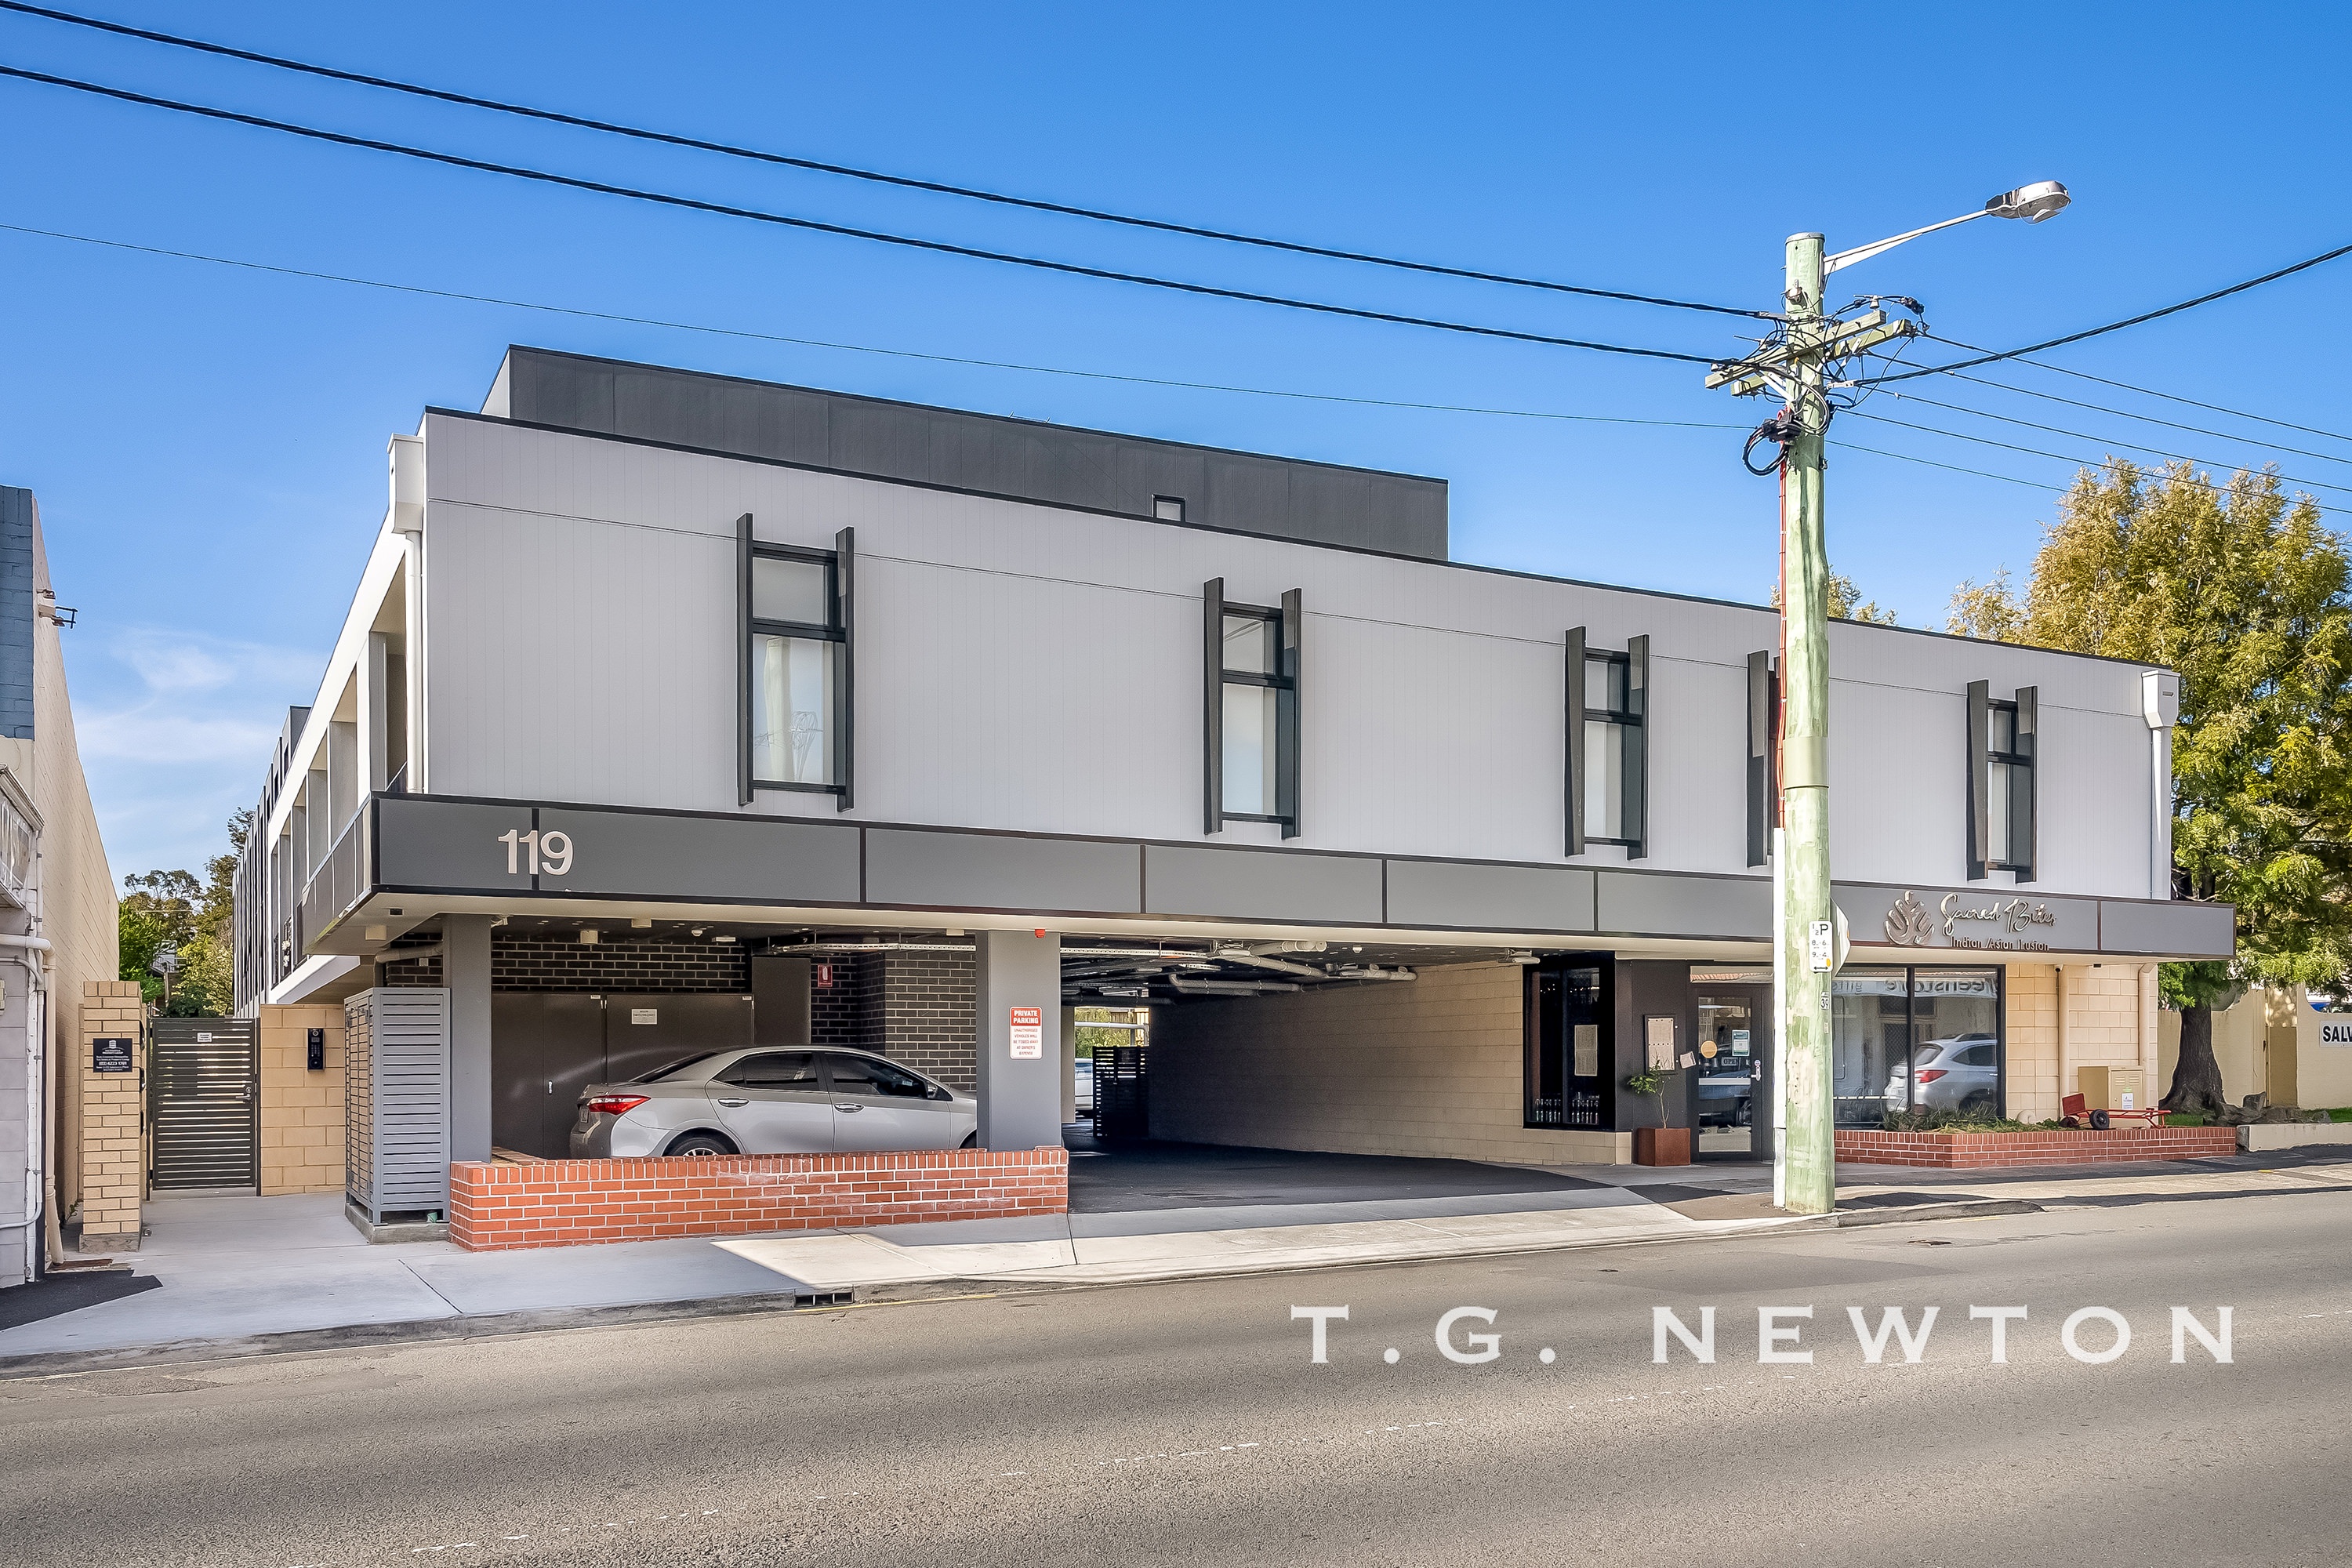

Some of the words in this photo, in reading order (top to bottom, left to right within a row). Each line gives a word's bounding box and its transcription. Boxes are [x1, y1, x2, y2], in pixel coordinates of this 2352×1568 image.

[497, 829, 574, 876] 119
[1940, 892, 2002, 936] Sacred
[2003, 898, 2057, 933] Bites
[1951, 936, 1982, 948] Indian
[1986, 937, 2013, 949] Asian
[2322, 1025, 2352, 1042] SALV
